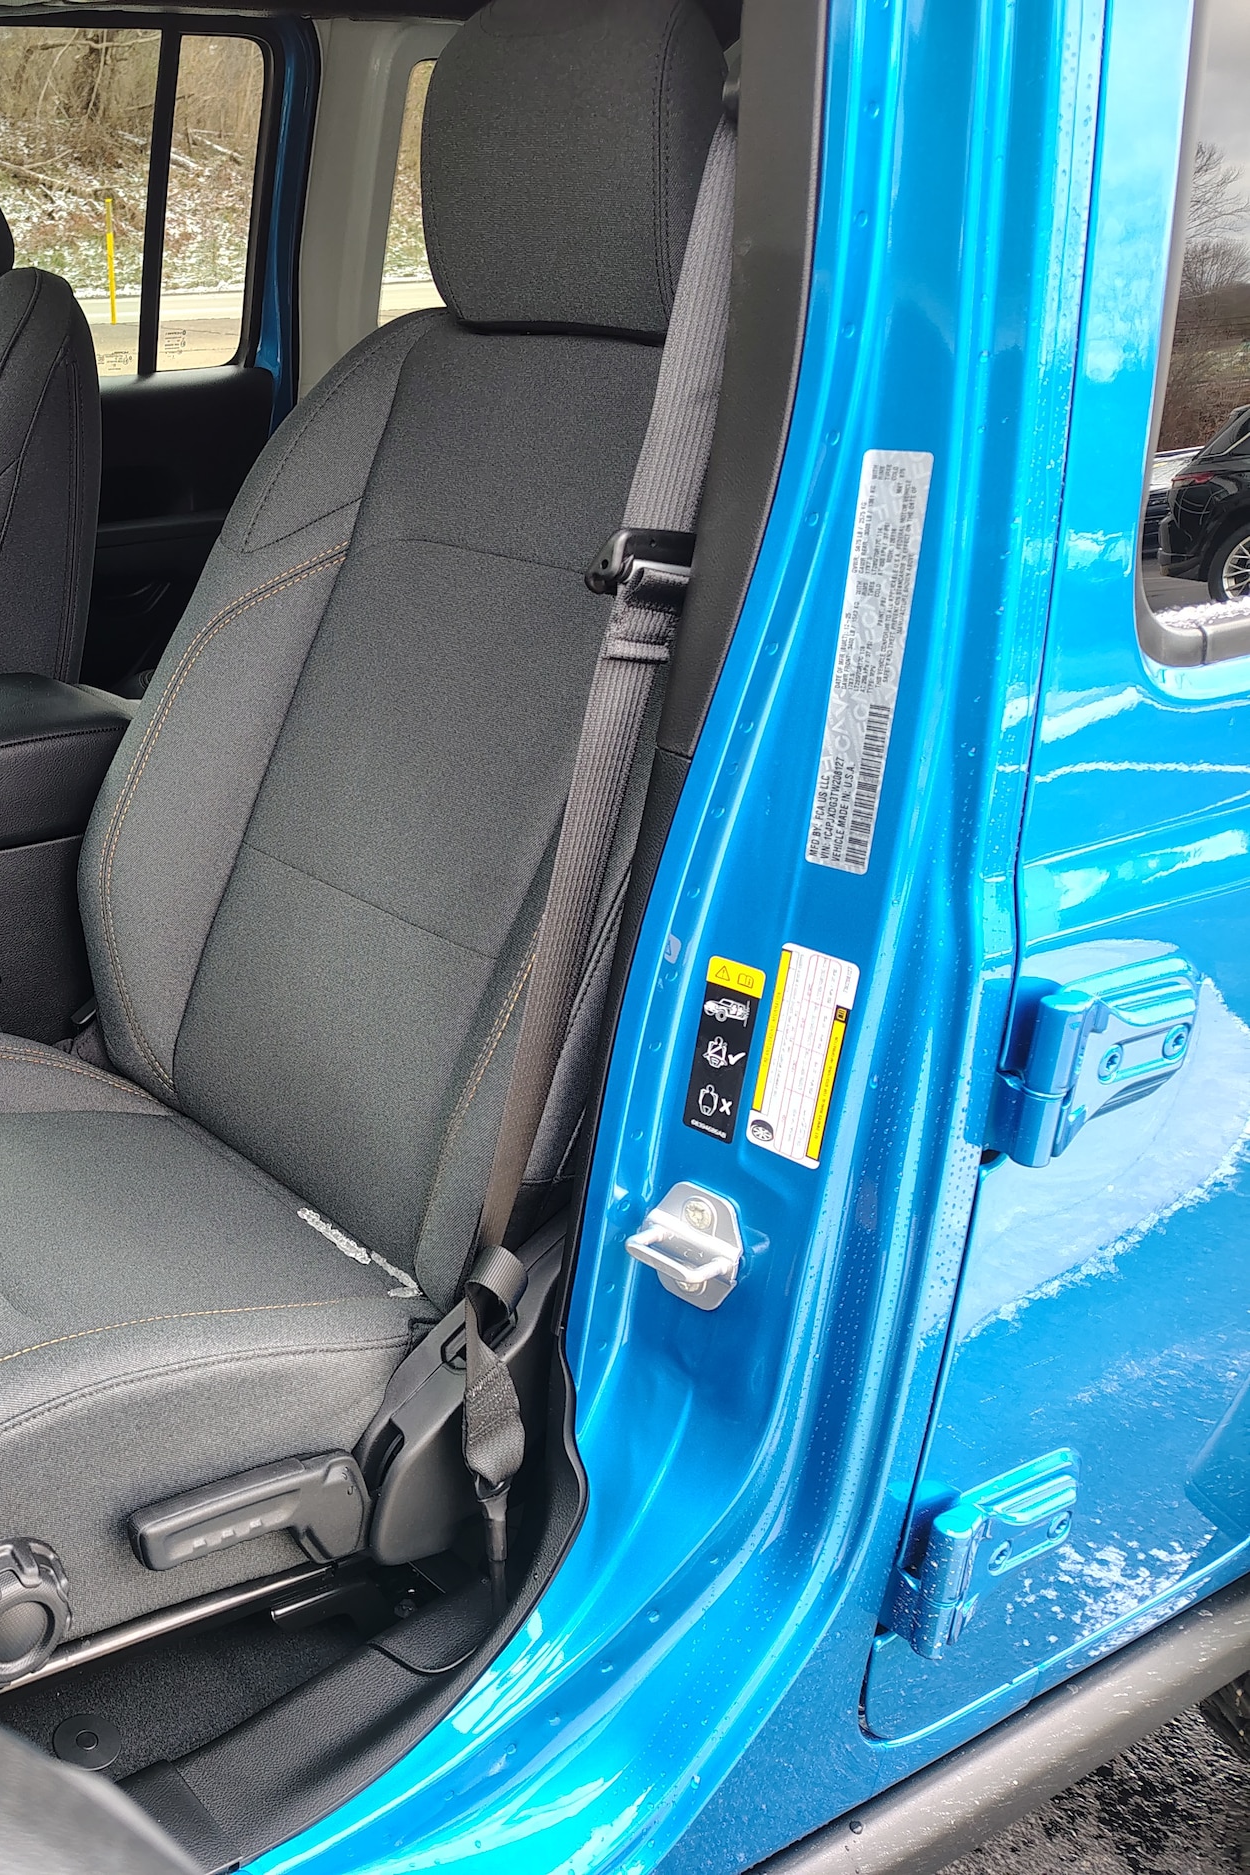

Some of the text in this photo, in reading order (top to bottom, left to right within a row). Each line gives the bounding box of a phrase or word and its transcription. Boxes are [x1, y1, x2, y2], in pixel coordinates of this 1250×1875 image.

[843, 761, 855, 788] U.S.A.
[808, 774, 830, 857] MFD BY: FCA US LLC
[836, 803, 848, 828] MADE
[820, 842, 830, 860] VIN:
[831, 828, 844, 862] VEHICLE
